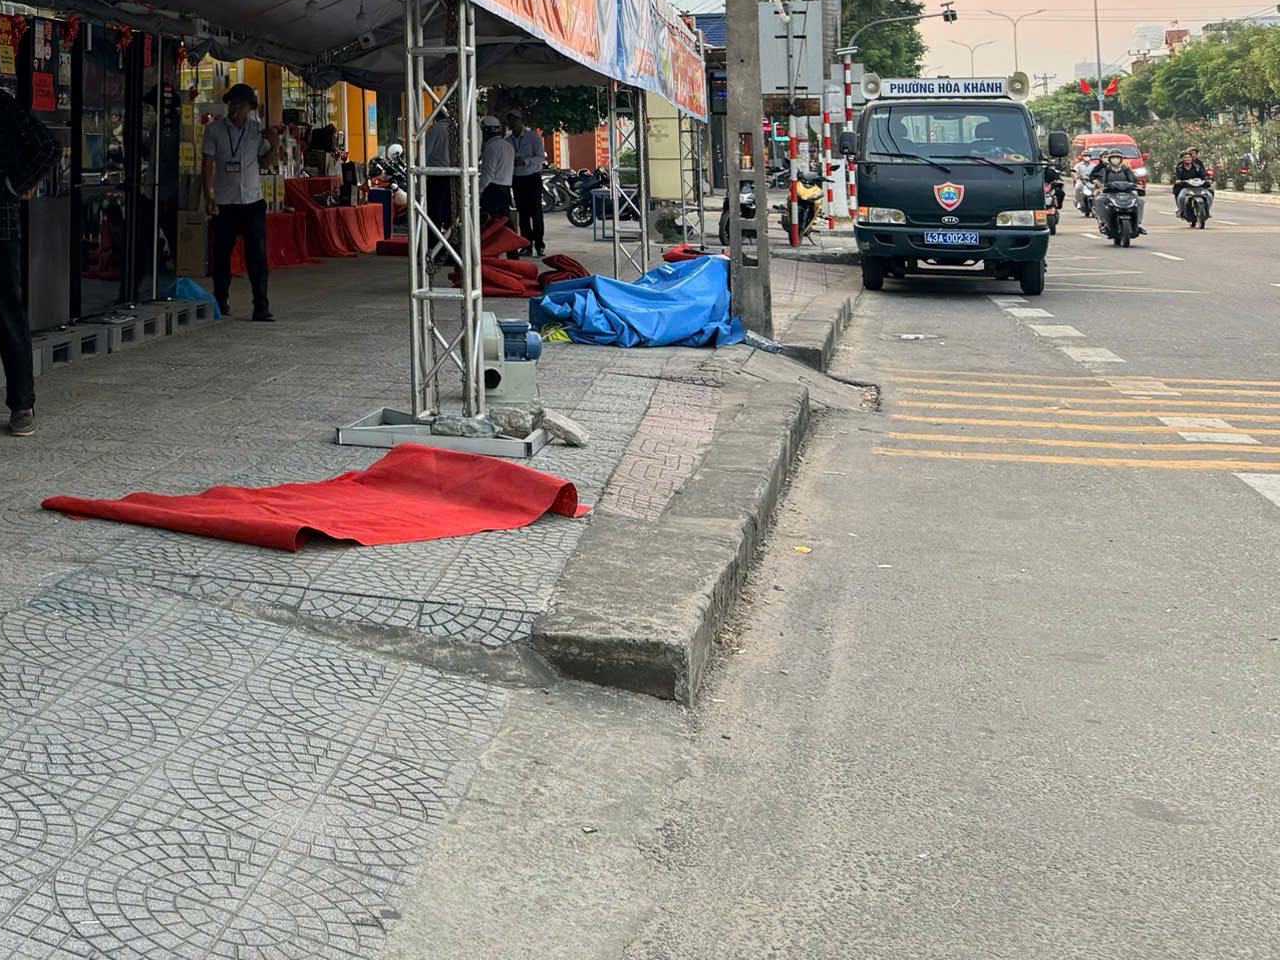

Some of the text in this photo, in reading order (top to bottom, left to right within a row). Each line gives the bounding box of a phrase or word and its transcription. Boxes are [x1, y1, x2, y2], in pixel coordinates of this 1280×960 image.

[889, 80, 1003, 94] PHƯỜNG HÒA KHÁNH
